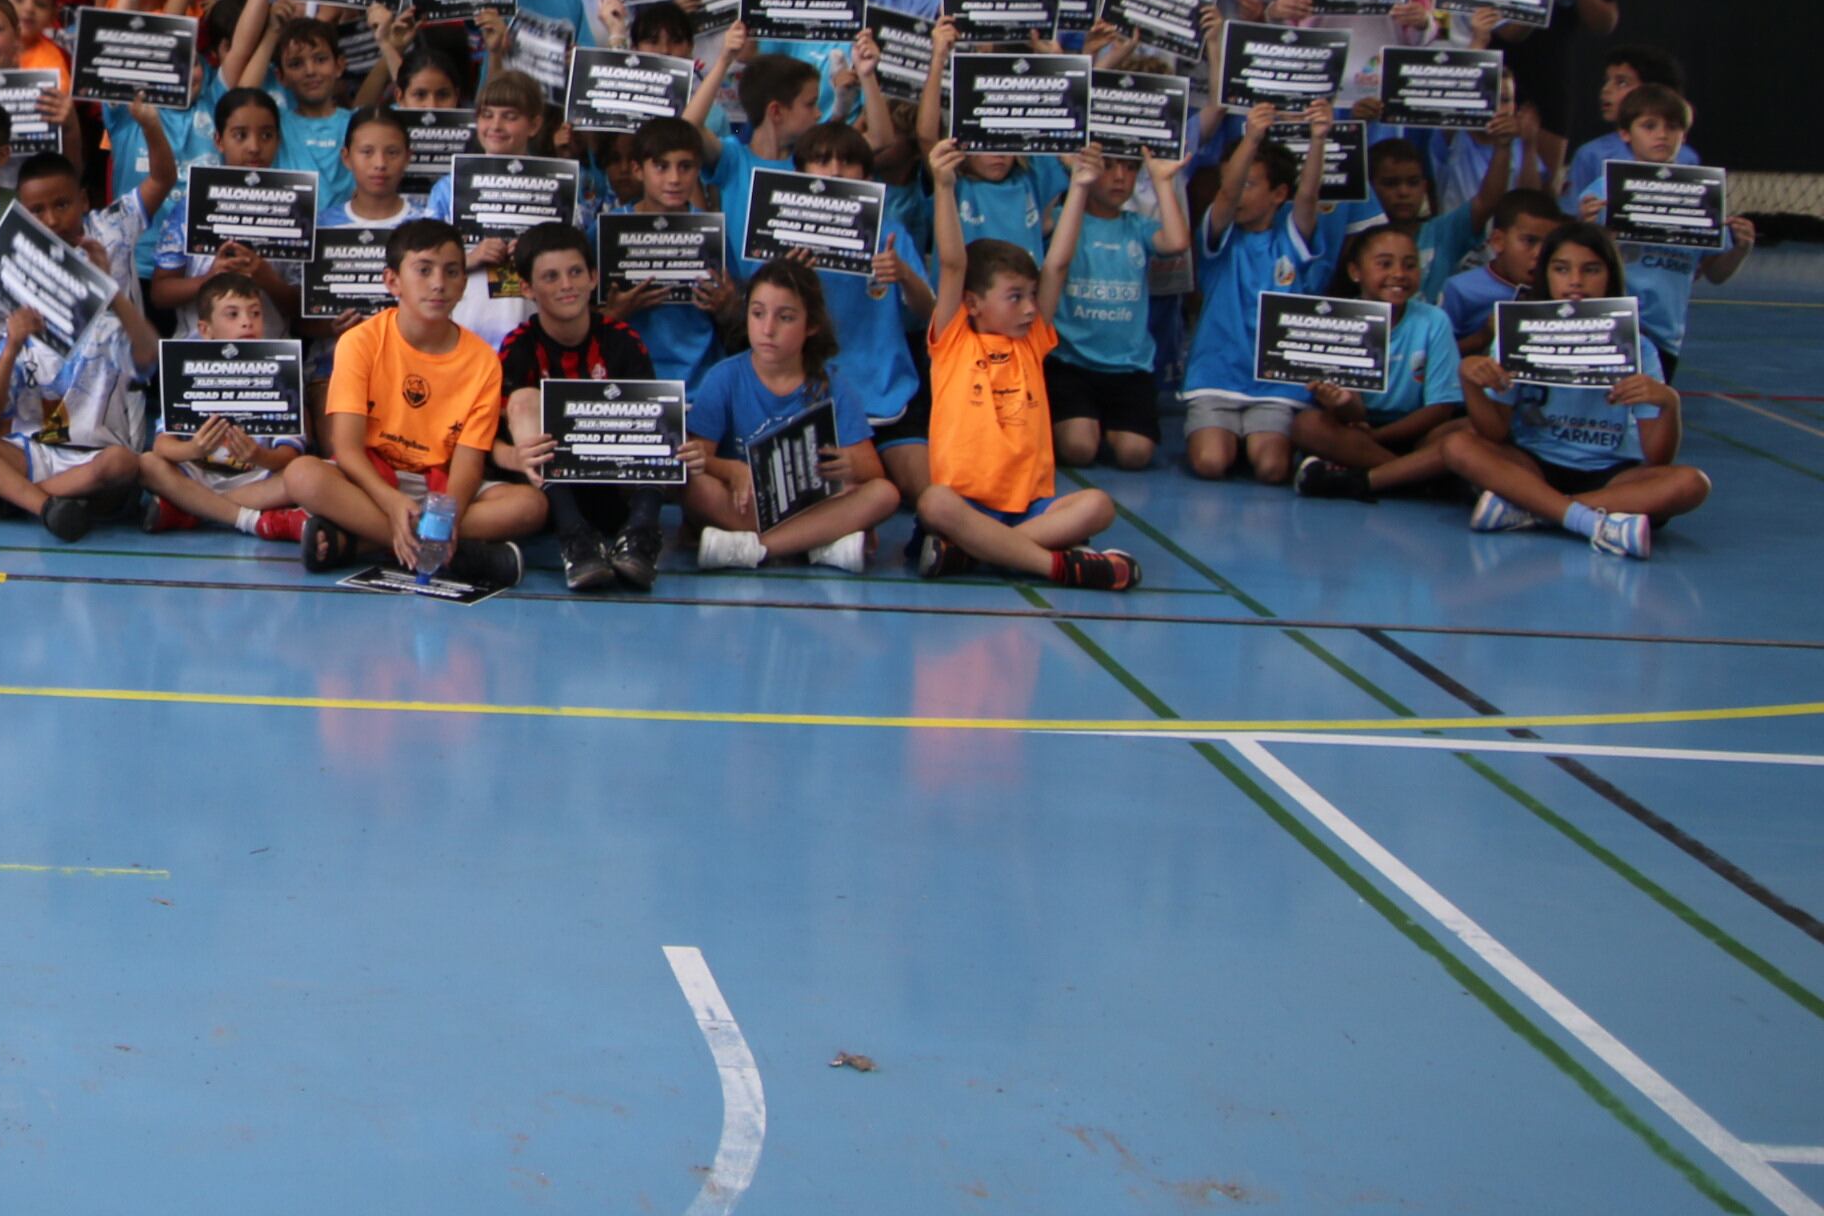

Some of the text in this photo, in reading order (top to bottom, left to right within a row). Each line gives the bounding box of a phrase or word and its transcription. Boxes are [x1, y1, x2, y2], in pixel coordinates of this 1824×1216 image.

[95, 28, 177, 48] BALONMANO
[1244, 42, 1333, 60] BALONMANO
[589, 64, 672, 84] BALONMANO
[1400, 64, 1482, 78] BALONMANO
[974, 76, 1069, 90] BALONMANO
[585, 89, 617, 99] CIUDAD
[632, 94, 669, 105] ARRECIFE
[973, 107, 1068, 116] CIUDAD DE ARRECIFE
[410, 128, 471, 141] ONMANO
[471, 174, 558, 190] BALONMANO
[1624, 178, 1705, 195] BALONMANO
[208, 185, 296, 203] BALONMANO
[771, 190, 862, 214] BALONMANO
[469, 203, 556, 214] CIUDAD DE ARRECIFE
[206, 214, 295, 226] CIUDAD DE ARRECIFE
[767, 219, 858, 237] CIUDAD DE ARRECIFE
[619, 232, 704, 245] BALONMANO
[1073, 305, 1134, 321] Arrecife
[1279, 313, 1368, 333] BALONMANO
[1520, 318, 1615, 331] BALONMANO
[1276, 340, 1367, 356] CIUDAD DE ARRECIFE
[184, 360, 279, 374] BALONMANO
[183, 391, 280, 399] CIUDAD DE ARRECIFE
[565, 401, 661, 416] BALONMANO
[564, 433, 662, 443] CIUDAD DE ARRECIFE
[1552, 426, 1625, 448] CARMEN
